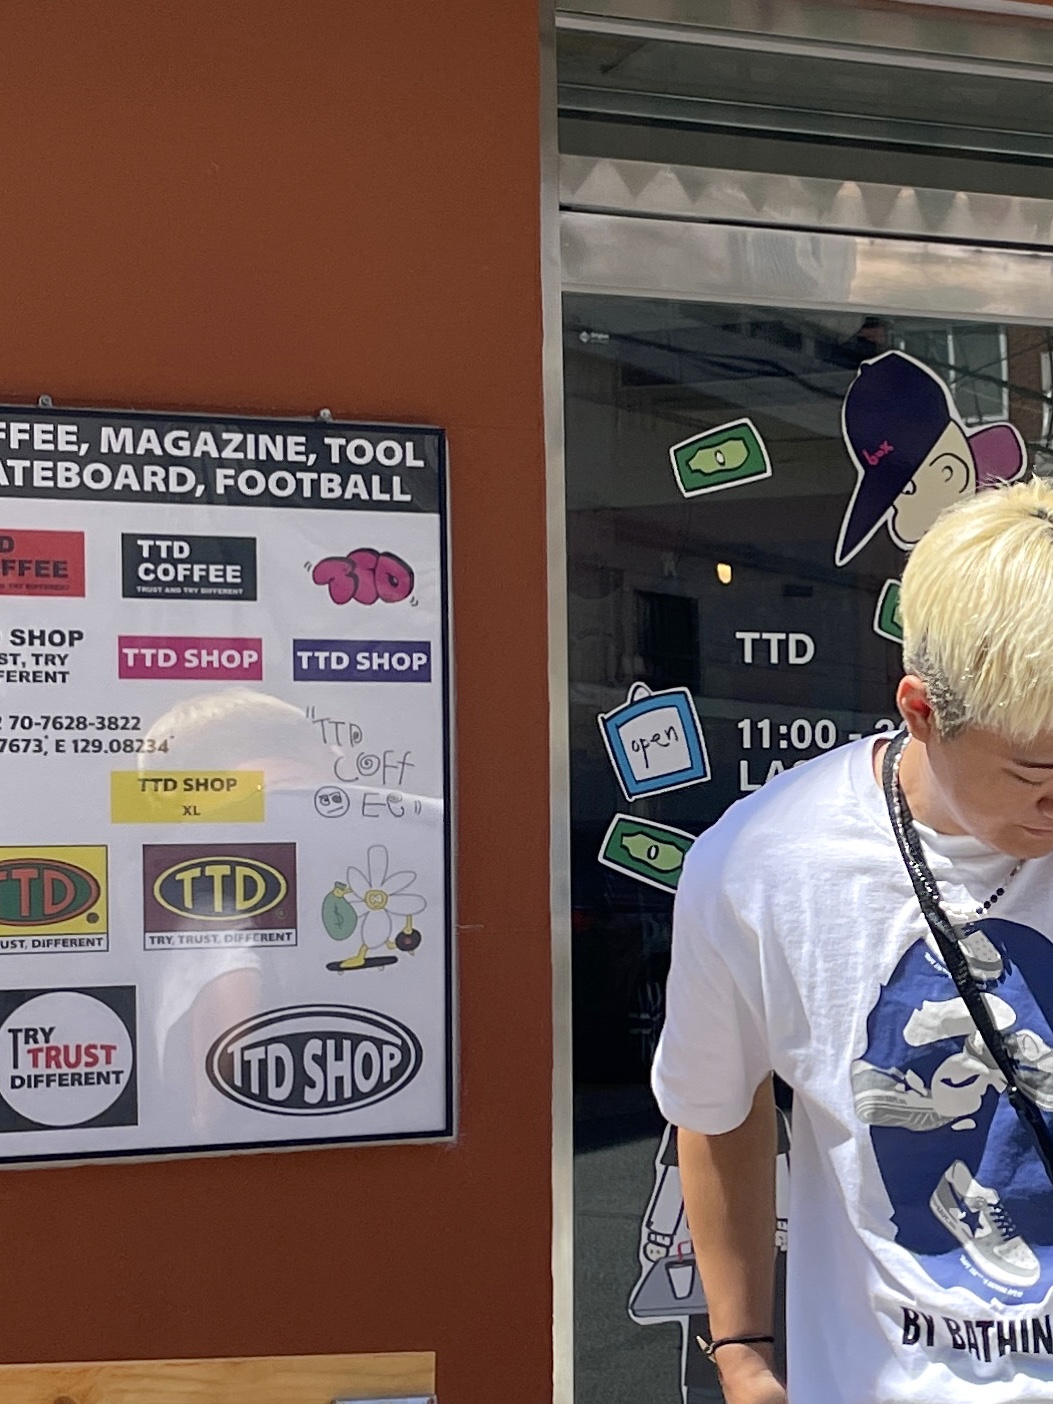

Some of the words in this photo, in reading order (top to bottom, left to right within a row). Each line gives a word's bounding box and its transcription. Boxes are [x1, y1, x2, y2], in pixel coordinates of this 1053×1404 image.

[101, 427, 316, 464] MAGAZINE,
[325, 437, 425, 468] TOOL
[216, 469, 411, 501] FOOTBALL
[137, 540, 190, 559] TTD
[138, 563, 241, 583] COFFEE
[165, 586, 182, 594] AND
[200, 587, 243, 595] DIFFERENT
[10, 629, 84, 647] SHOP
[735, 631, 815, 665] TTD
[31, 653, 69, 666] TRY
[122, 648, 178, 667] TTD
[184, 649, 259, 668] SHOP
[297, 651, 349, 670] TTD
[356, 652, 428, 671] SHOP
[9, 715, 141, 731] 70-7628-3822
[737, 718, 836, 749] 11:00
[55, 739, 66, 753] E
[631, 724, 679, 768] open
[138, 778, 177, 792] TTD
[183, 778, 237, 792] SHOP
[182, 806, 201, 816] XL
[0, 867, 76, 918] TD
[175, 864, 266, 913] TTD
[32, 937, 104, 949] DIFFERENT
[149, 935, 175, 946] TRY,
[177, 933, 221, 945] TRUST,
[224, 931, 293, 943] DIFFERENT
[8, 1026, 56, 1069] TRY
[27, 1044, 117, 1069] TRUST
[10, 1070, 124, 1089] DIFFERENT
[227, 1040, 295, 1101] TTD
[303, 1038, 402, 1104] SHOP
[901, 1305, 935, 1347] BY
